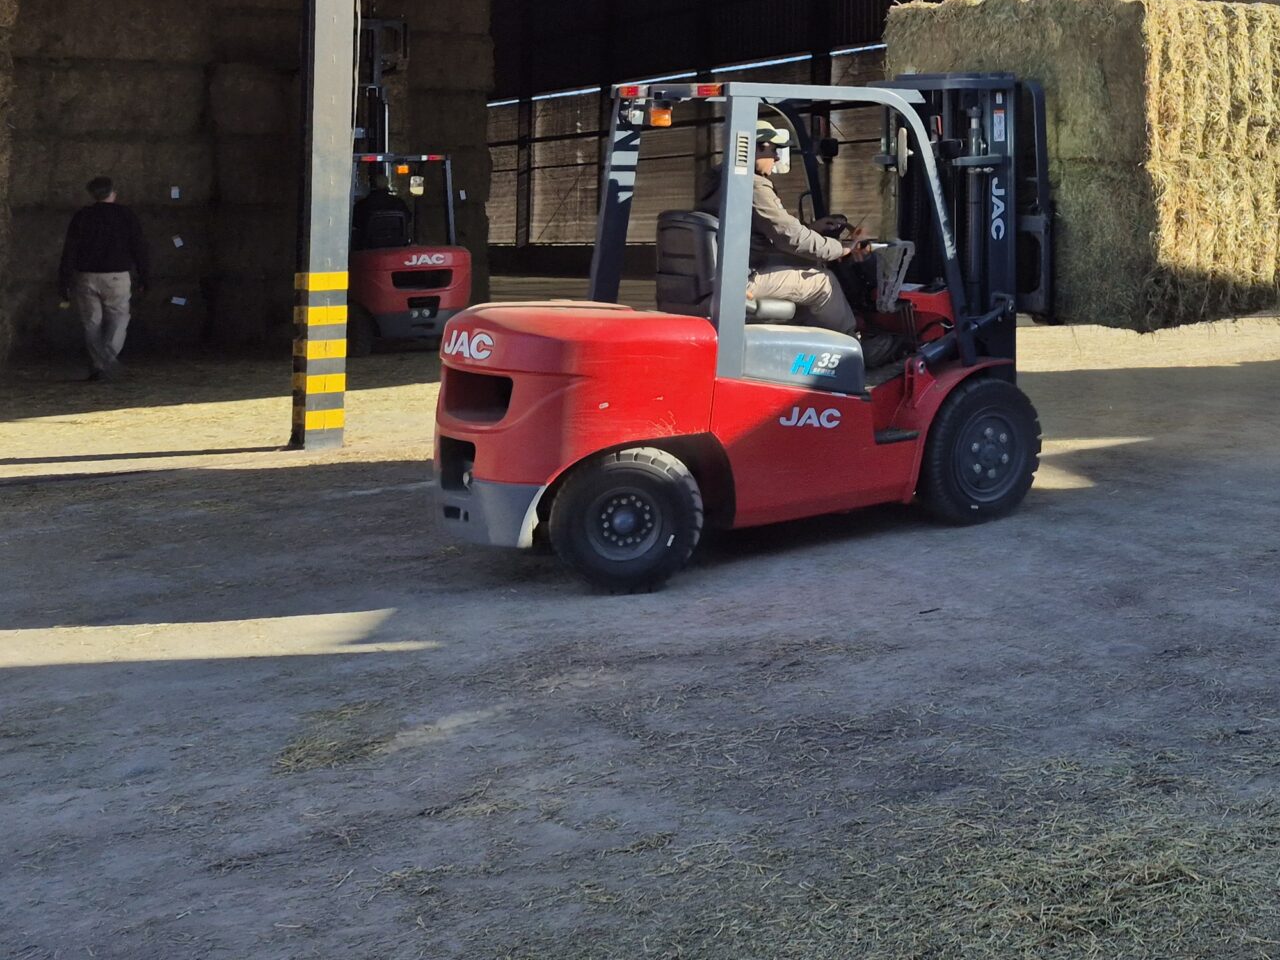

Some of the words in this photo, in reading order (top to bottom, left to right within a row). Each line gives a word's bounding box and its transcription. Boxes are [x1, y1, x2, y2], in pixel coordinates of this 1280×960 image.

[991, 177, 1005, 240] JAC
[404, 253, 445, 266] JAC
[444, 330, 494, 360] JAC
[790, 352, 816, 376] H
[817, 352, 842, 369] 35
[779, 406, 842, 429] JAC
